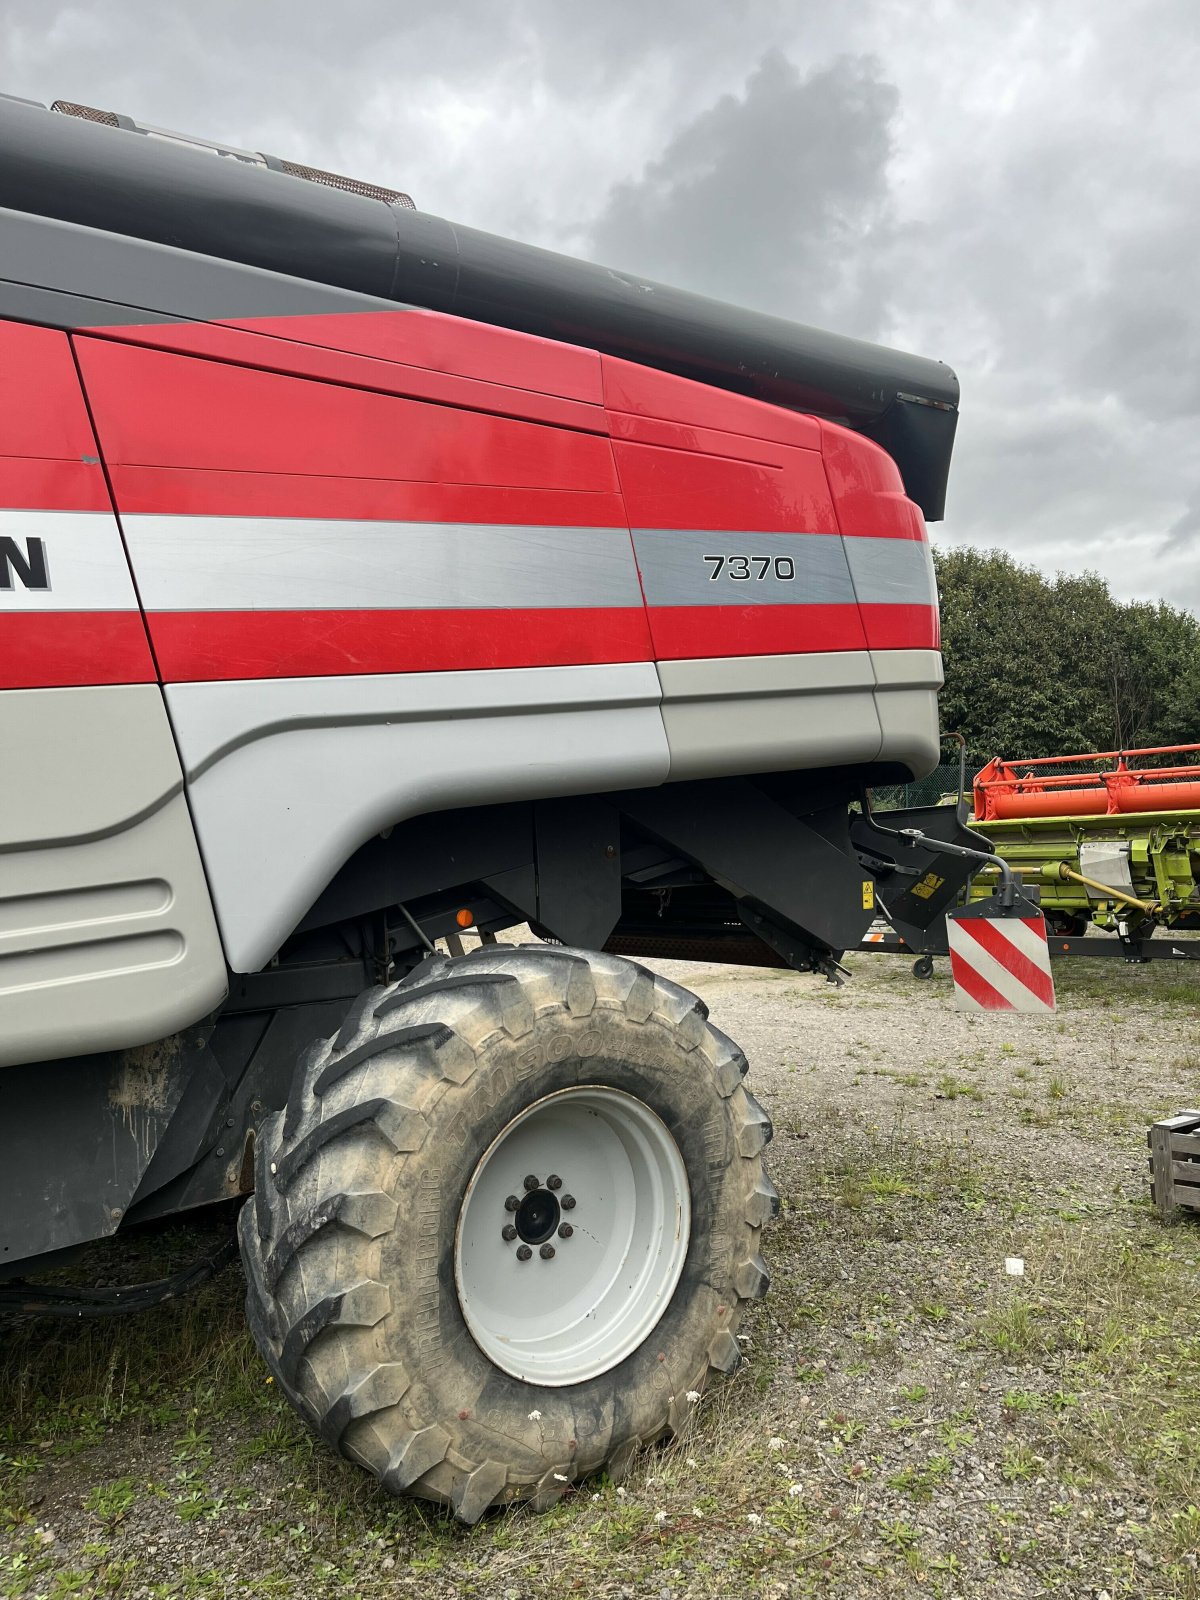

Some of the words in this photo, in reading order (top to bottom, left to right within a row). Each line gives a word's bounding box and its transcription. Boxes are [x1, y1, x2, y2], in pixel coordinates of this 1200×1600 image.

[703, 555, 796, 581] 7370
[416, 1168, 444, 1385] TRELLEBORG
[704, 1114, 729, 1290] TRELLEBORG
